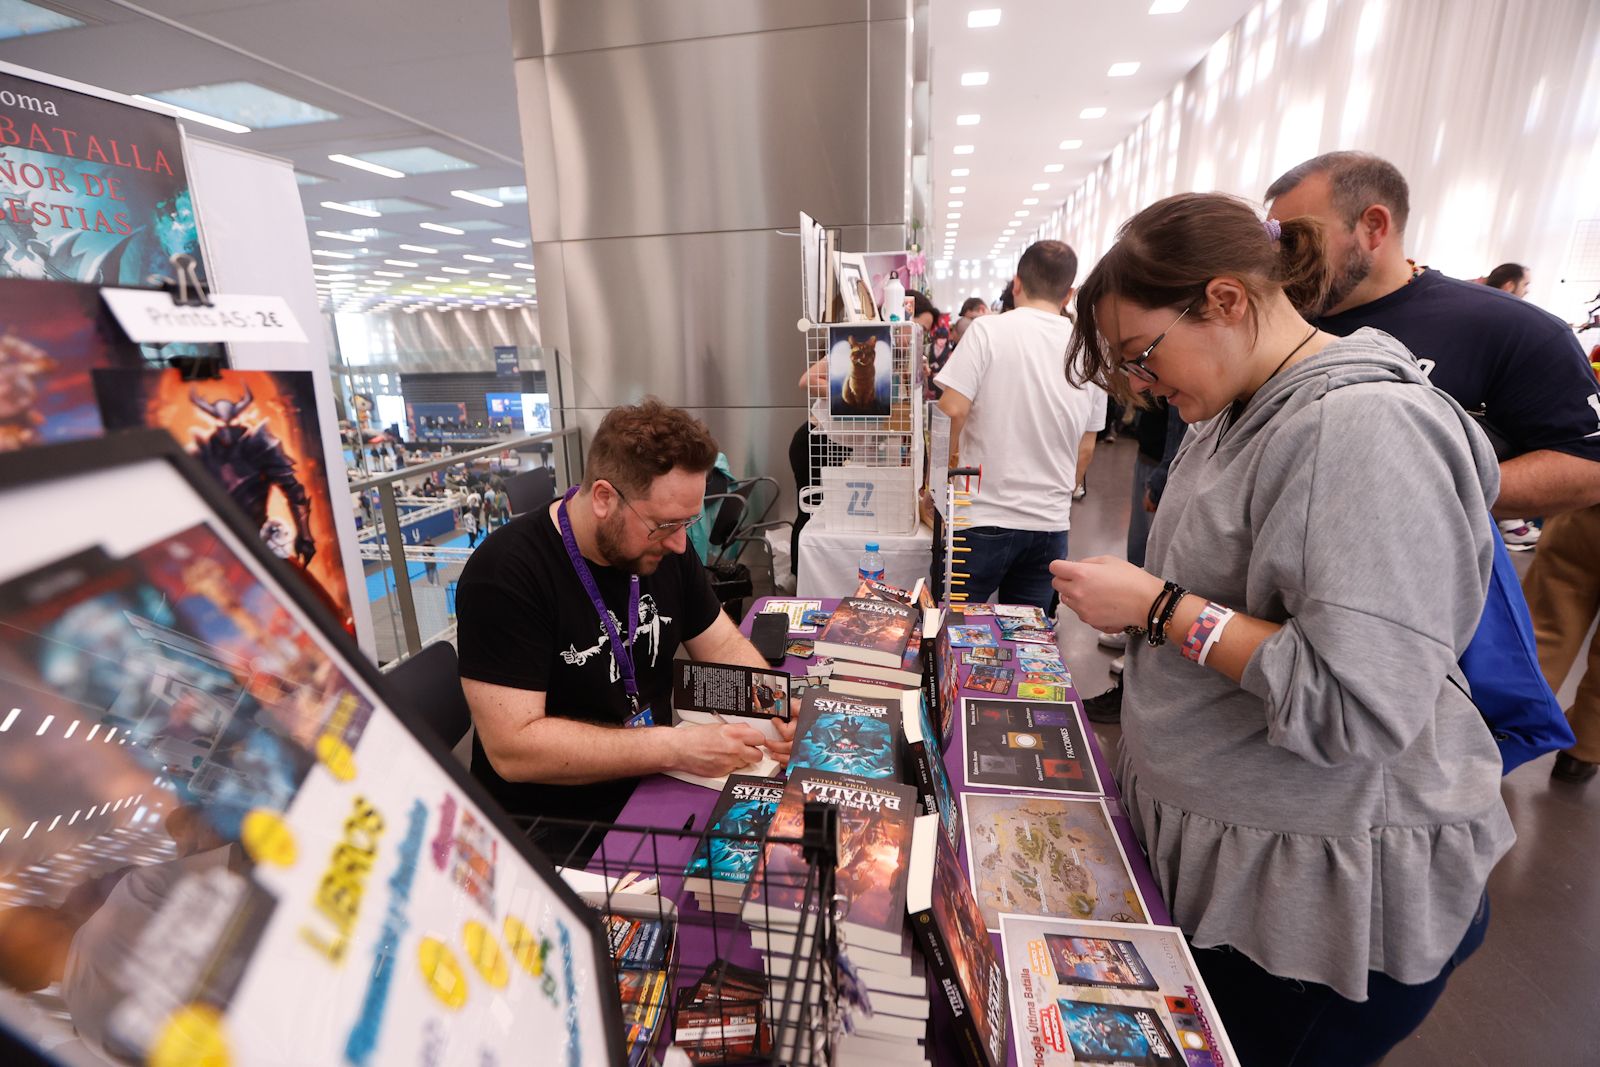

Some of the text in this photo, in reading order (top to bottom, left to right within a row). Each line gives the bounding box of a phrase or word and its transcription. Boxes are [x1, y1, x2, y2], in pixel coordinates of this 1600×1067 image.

[0, 115, 175, 177] BATALLA
[80, 172, 128, 202] DE
[255, 311, 284, 328] 2€
[814, 699, 888, 715] BESTIAS
[1059, 727, 1076, 759] FACCIONES
[731, 785, 784, 799] STIAS
[800, 781, 902, 811] BATALLA
[924, 793, 934, 816] BESTI
[866, 803, 881, 812] LA
[941, 977, 963, 1018] BATALLA
[1020, 967, 1034, 999] Batalla
[1025, 1001, 1039, 1033] Última
[1137, 1011, 1170, 1058] BESTIAS
